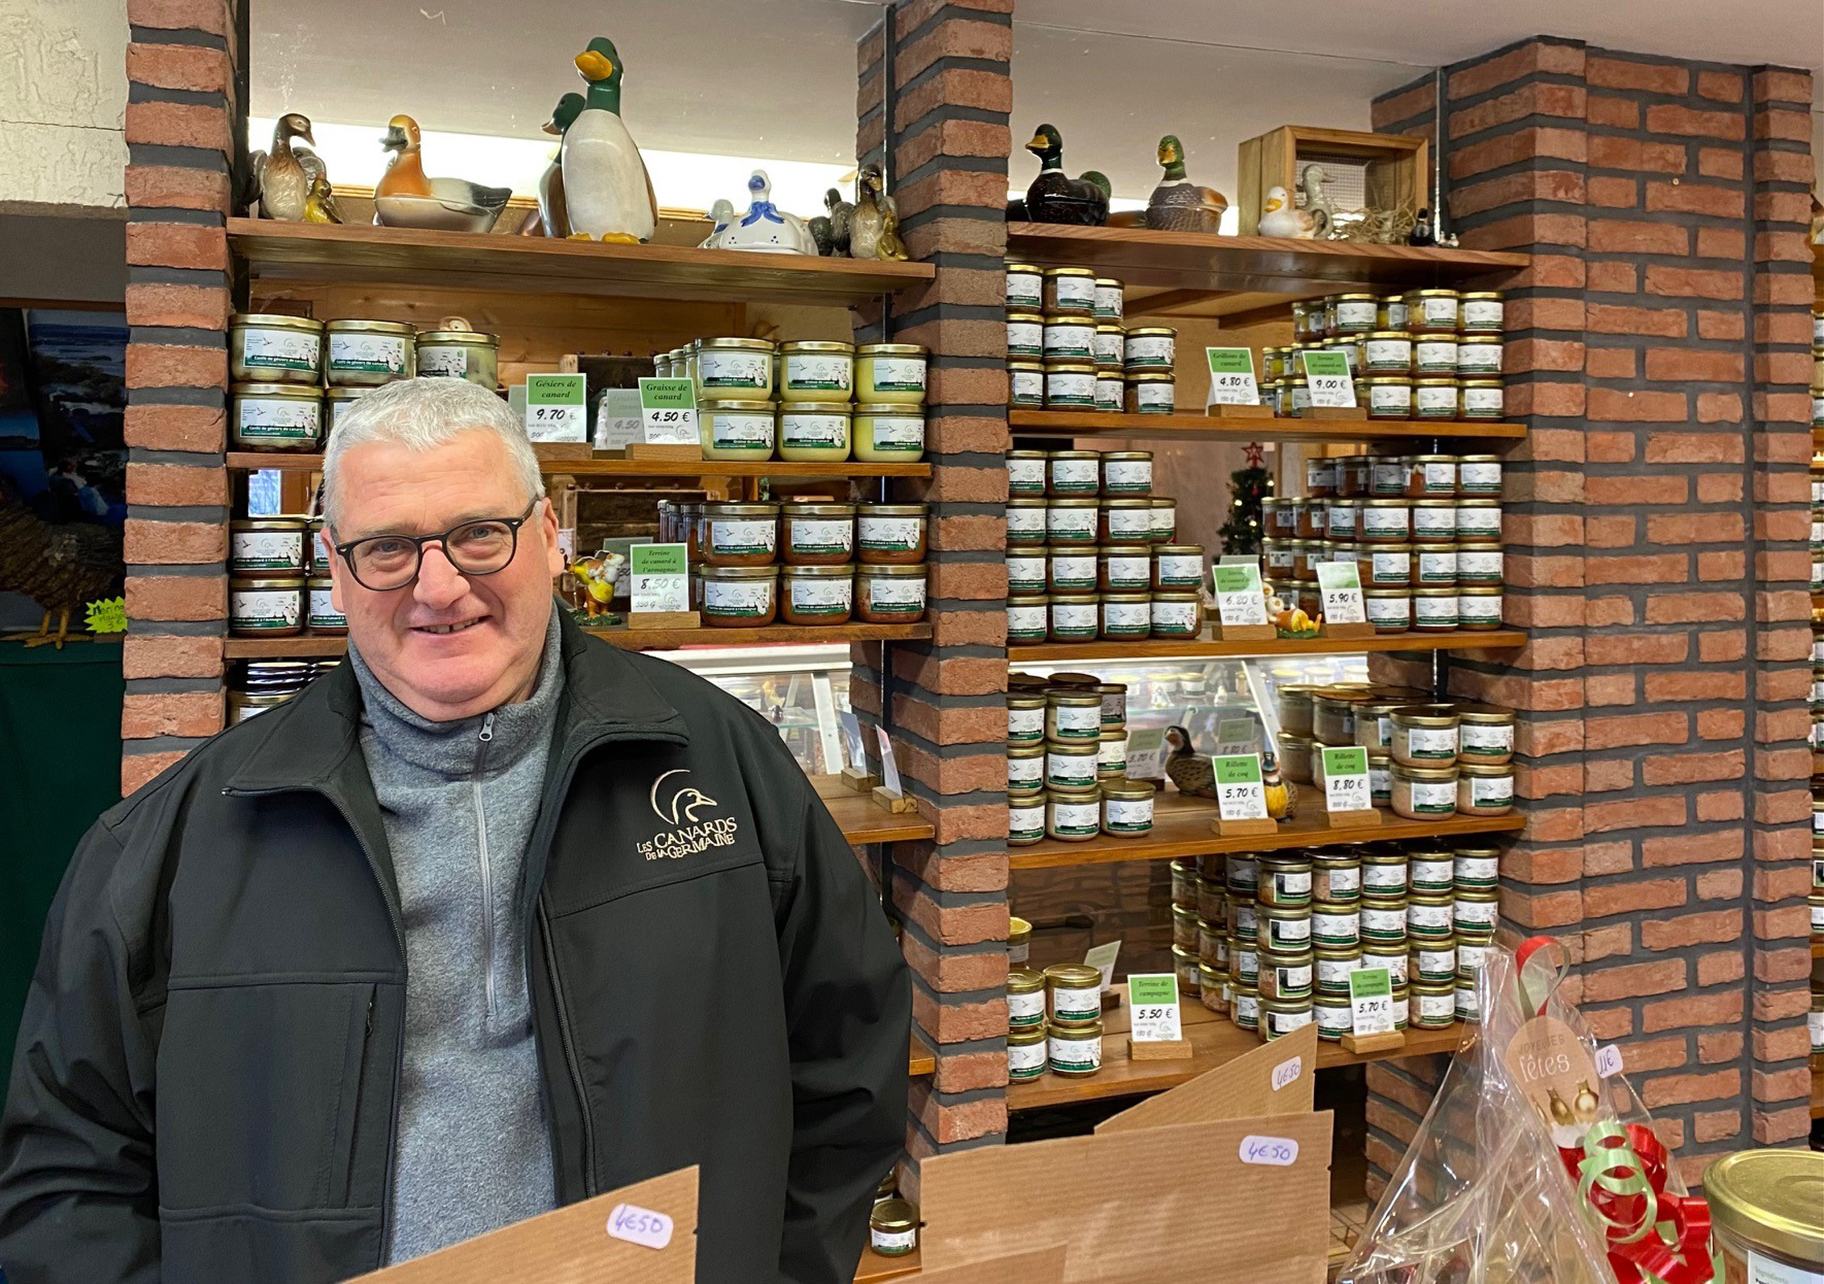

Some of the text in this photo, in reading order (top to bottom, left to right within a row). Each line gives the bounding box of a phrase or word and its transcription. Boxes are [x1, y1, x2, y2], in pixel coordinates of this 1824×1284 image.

[1220, 377, 1250, 386] 4.80 €
[1317, 380, 1337, 388] 9.00
[537, 409, 565, 420] 9.70
[652, 412, 690, 422] 4.50 €
[641, 578, 680, 589] 8.50 €
[1252, 595, 1258, 604] €
[1330, 593, 1357, 603] 5.90 €
[1333, 780, 1363, 790] 8.80 €
[1226, 787, 1258, 798] 5.70 €
[654, 817, 737, 848] CANARDS
[668, 833, 735, 858] GERMAINE
[1359, 1001, 1387, 1013] 5.70 €
[1139, 1008, 1172, 1019] 5.50 €
[1518, 1035, 1565, 1053] JOYEUSES
[1519, 1054, 1570, 1082] fêtes
